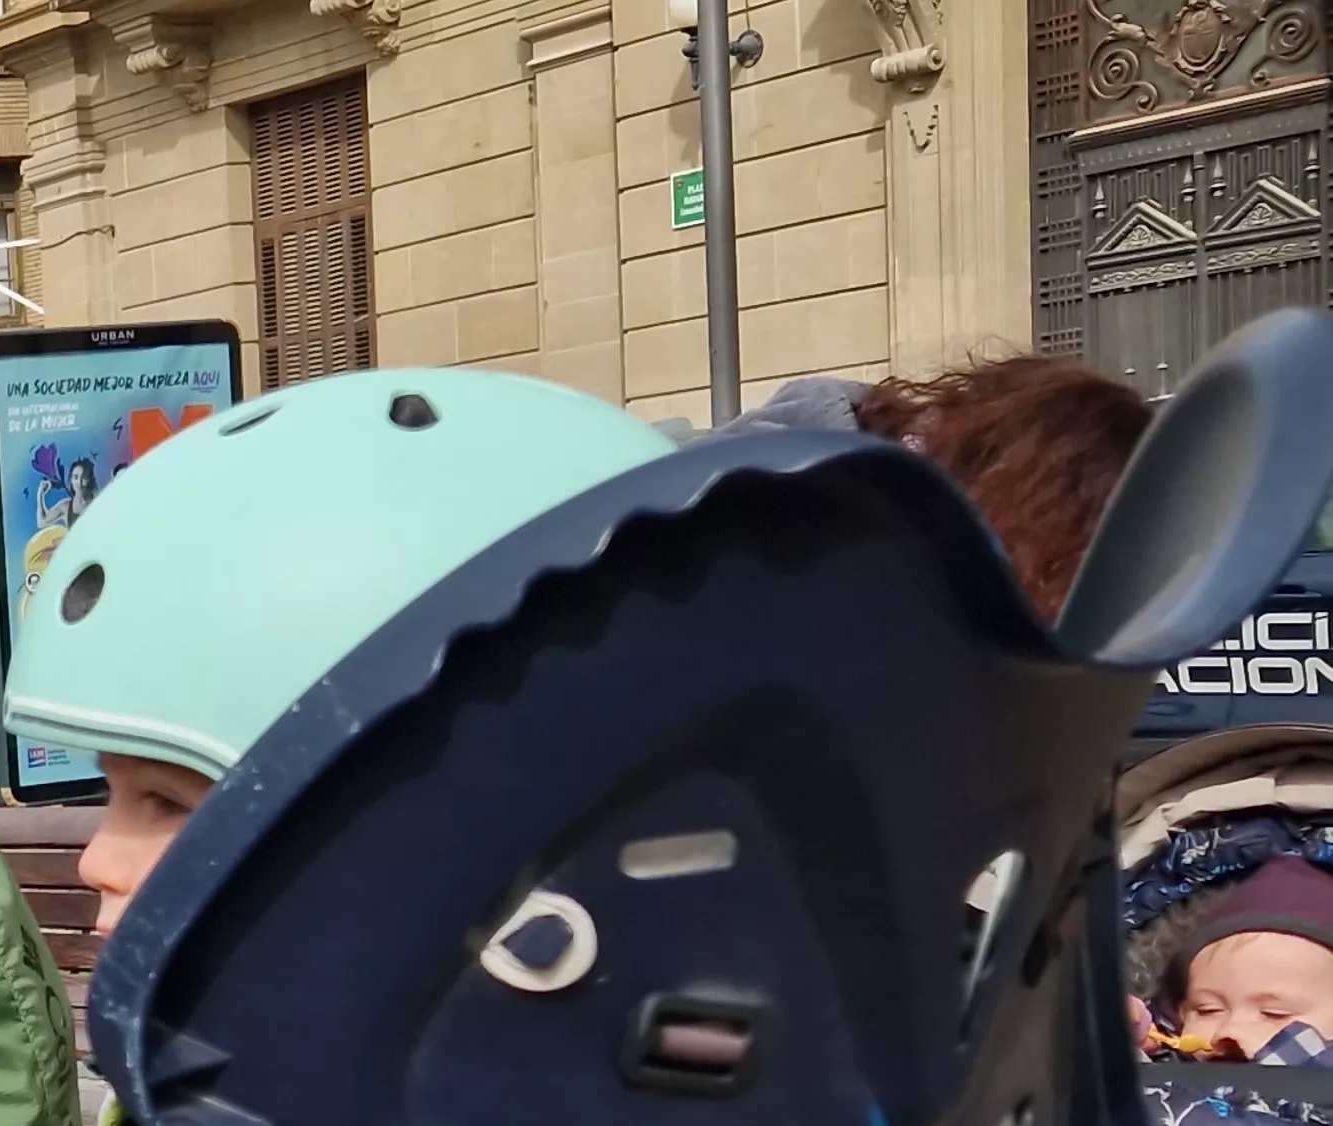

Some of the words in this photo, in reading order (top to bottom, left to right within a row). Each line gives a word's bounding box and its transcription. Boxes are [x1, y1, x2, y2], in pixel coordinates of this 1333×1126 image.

[91, 330, 135, 342] URBAN
[7, 382, 29, 397] UNA
[34, 378, 91, 396] SOCIEDAD
[93, 376, 134, 393] MEJOR
[138, 370, 189, 390] EMPIEZA
[41, 413, 76, 430] MUJER
